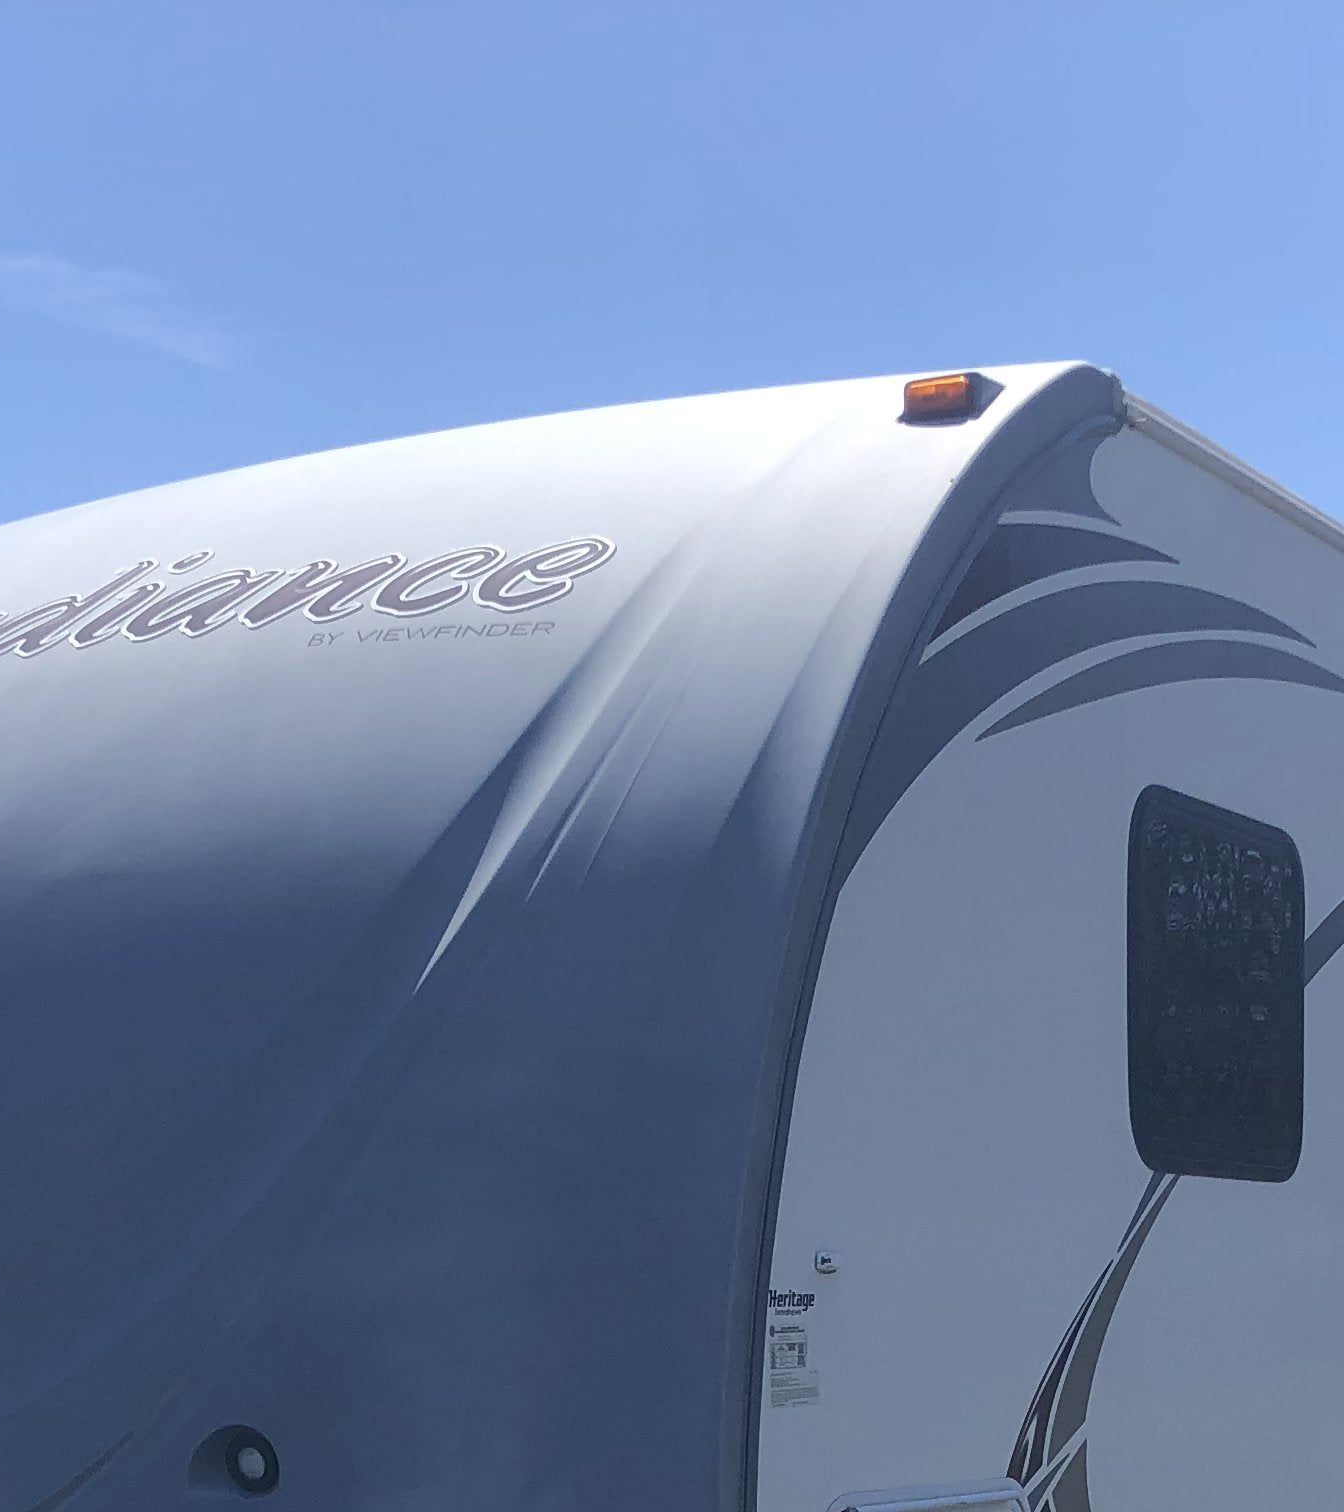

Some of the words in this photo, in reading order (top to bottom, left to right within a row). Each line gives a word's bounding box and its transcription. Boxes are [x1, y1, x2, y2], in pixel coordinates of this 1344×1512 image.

[306, 632, 344, 648] BY
[355, 622, 556, 643] VIEWFINDER
[768, 1289, 815, 1312] Heritage
